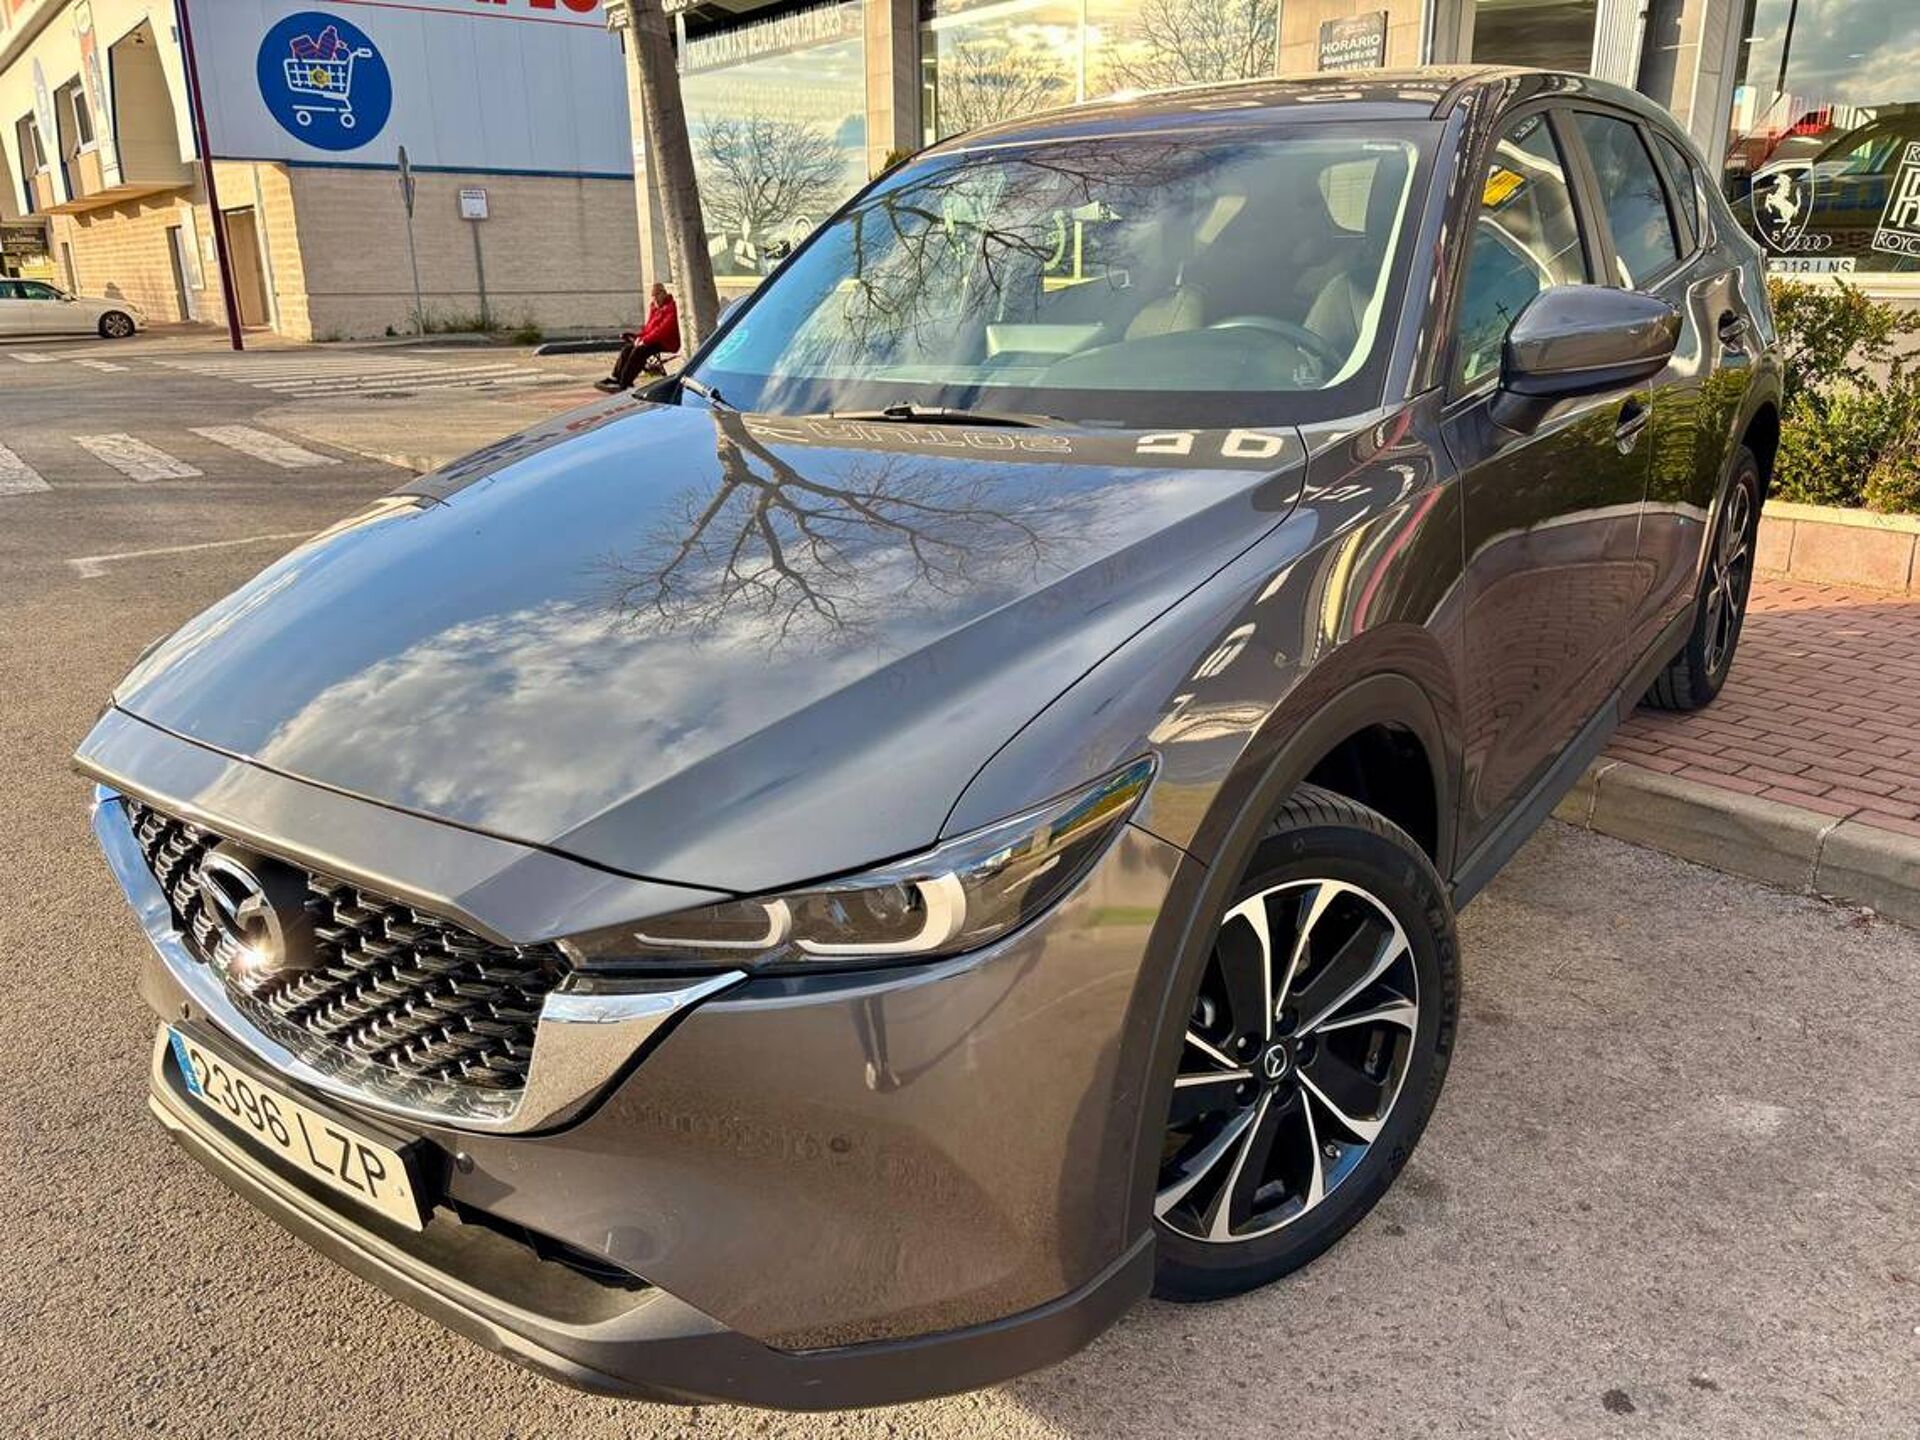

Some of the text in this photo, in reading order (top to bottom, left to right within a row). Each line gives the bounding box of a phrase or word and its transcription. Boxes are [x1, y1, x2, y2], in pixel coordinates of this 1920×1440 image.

[1321, 34, 1381, 54] HORARIO
[191, 1048, 387, 1198] 2396 LZP
